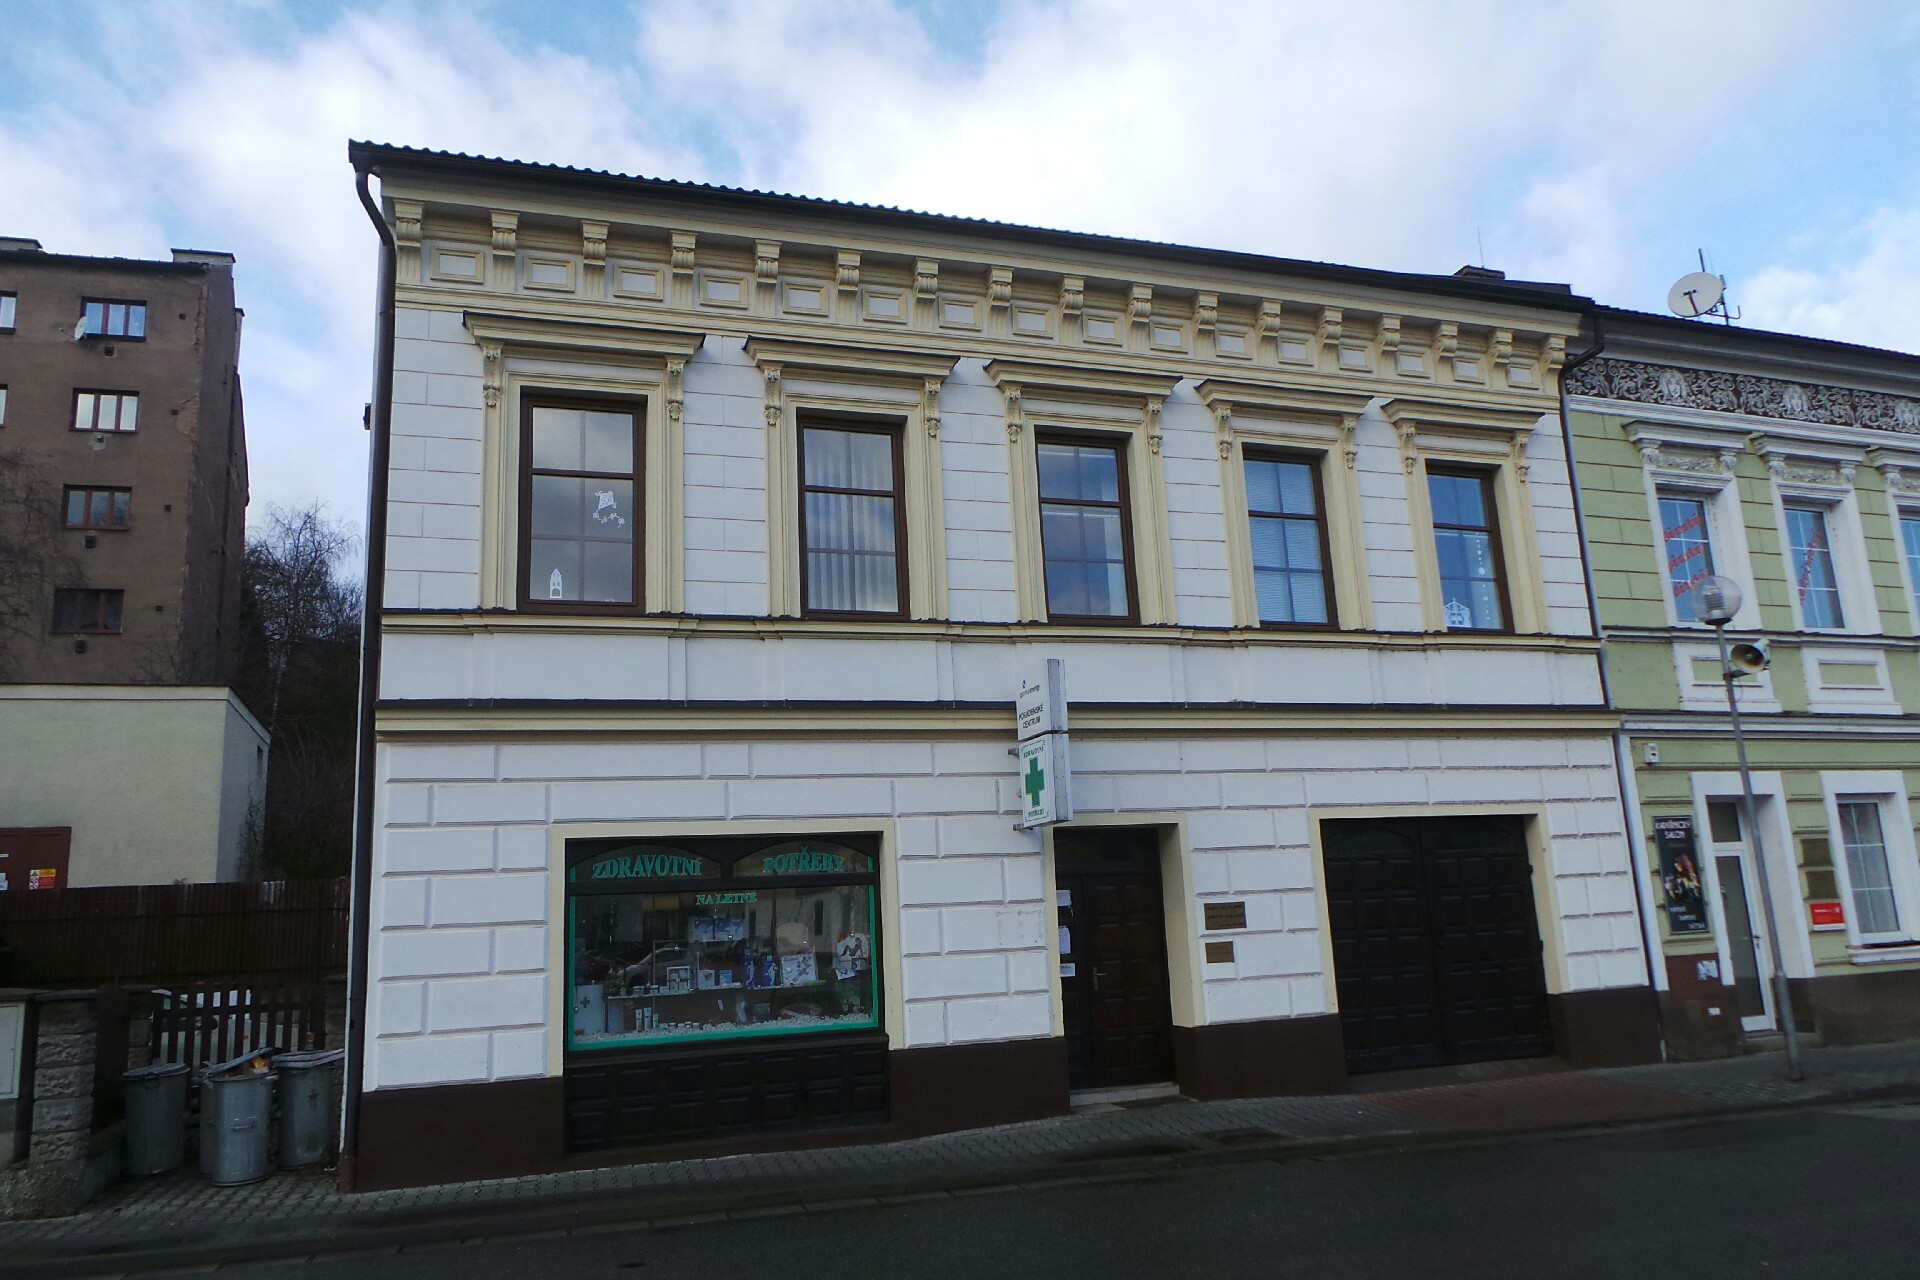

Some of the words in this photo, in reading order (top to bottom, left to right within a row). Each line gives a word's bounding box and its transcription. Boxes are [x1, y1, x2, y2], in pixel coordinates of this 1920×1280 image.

[1023, 715, 1040, 728] CENTRUM
[1665, 830, 1685, 839] SALON
[592, 854, 702, 879] ZDRAVOTNÍ
[763, 847, 844, 873] POTŘEBY
[695, 894, 714, 905] NA
